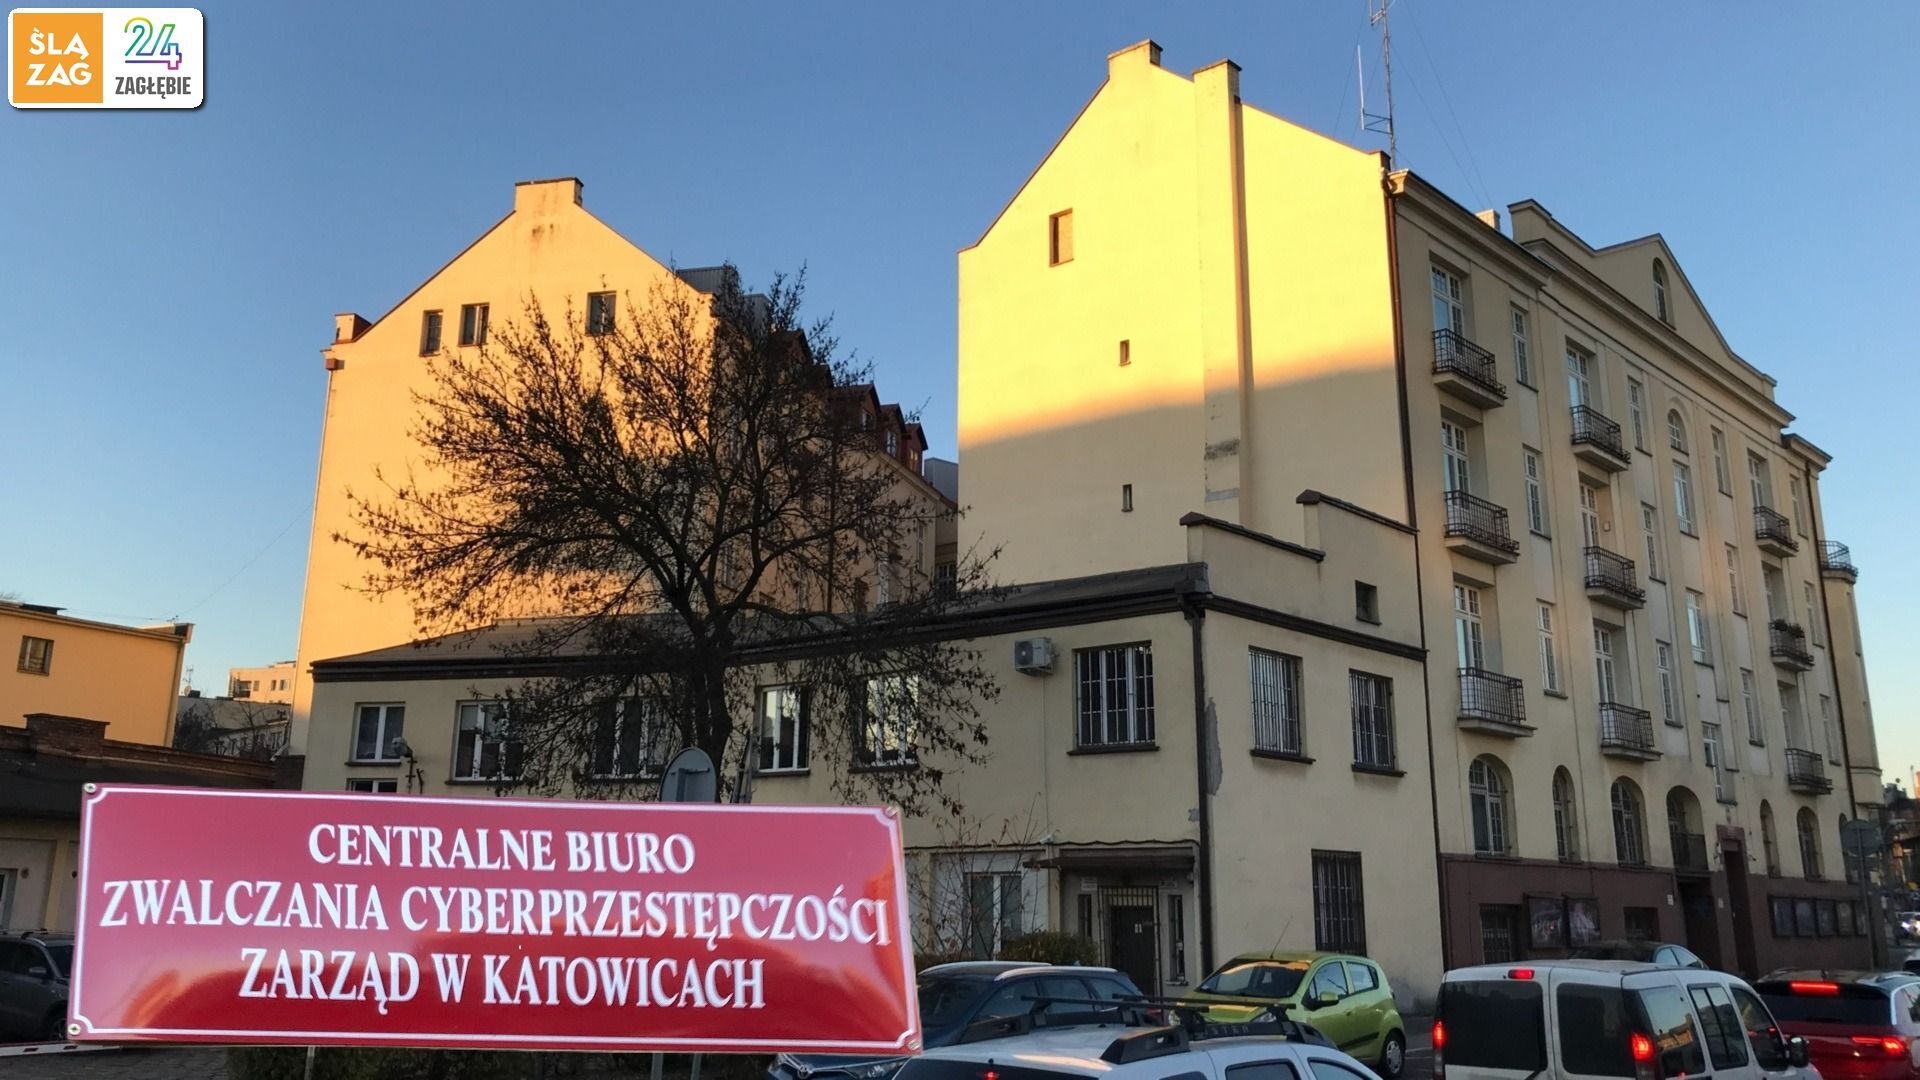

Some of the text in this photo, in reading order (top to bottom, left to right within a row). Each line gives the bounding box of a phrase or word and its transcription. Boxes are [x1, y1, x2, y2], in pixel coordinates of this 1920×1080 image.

[308, 823, 696, 874] CENTRALNE BIURO
[100, 879, 891, 951] ZWALCZANIA CYBERPRZESTĘPCZOŚCI
[239, 947, 766, 1016] ZARZĄD W KATOWICACH
